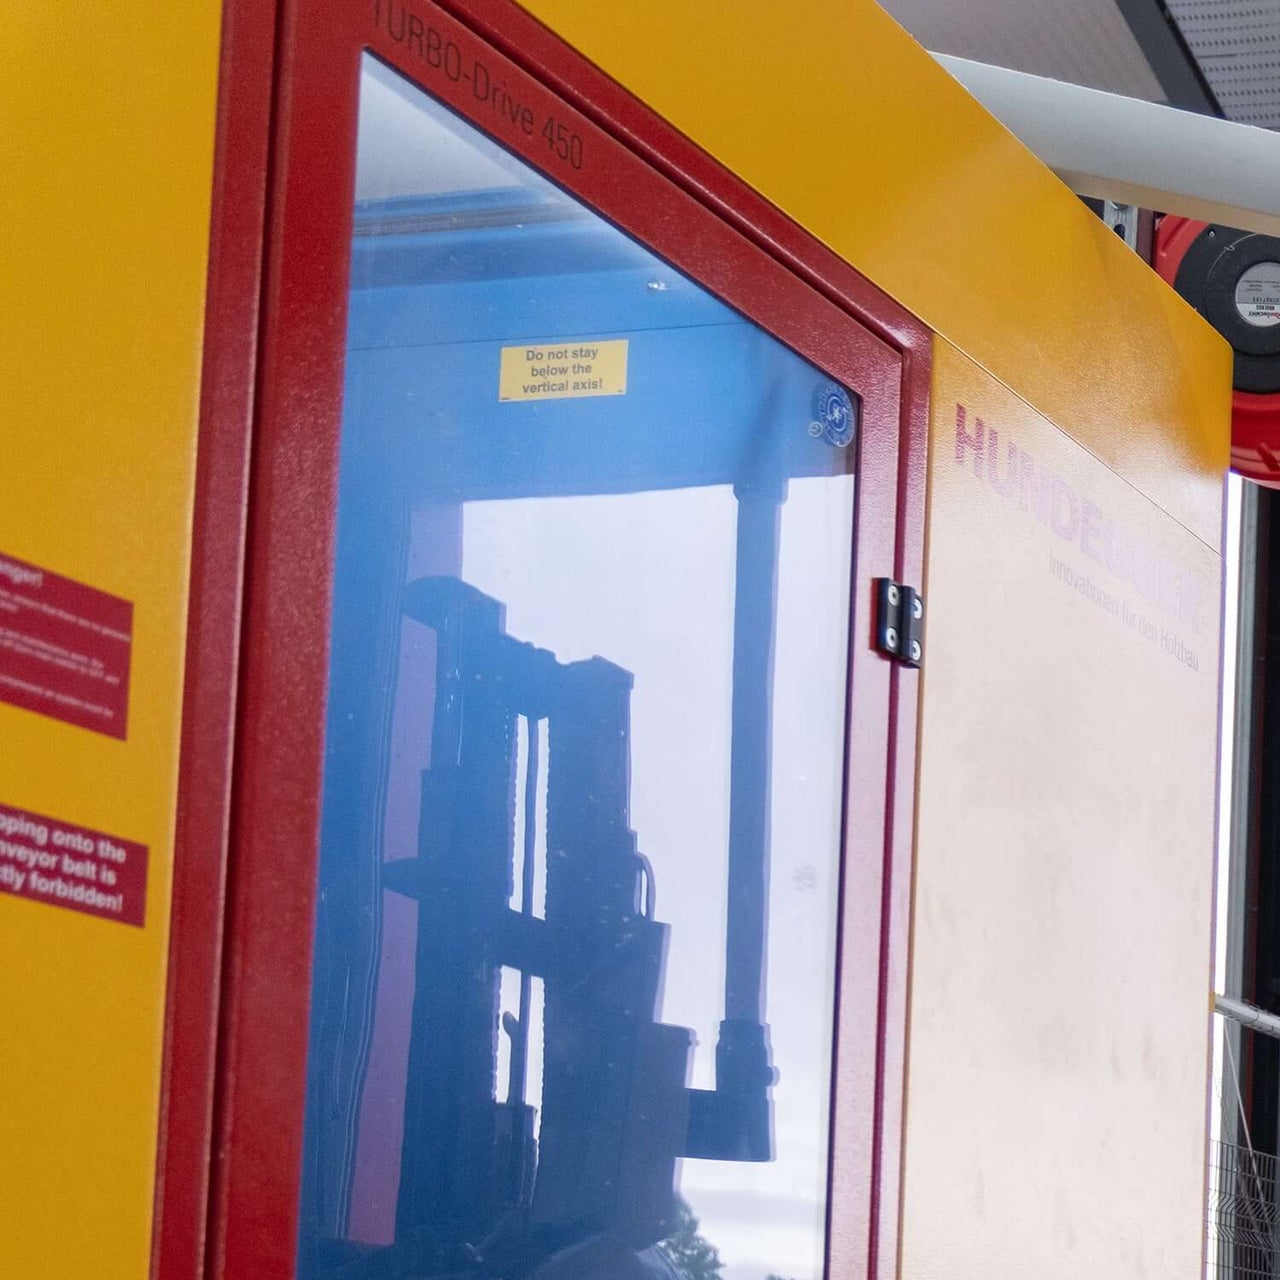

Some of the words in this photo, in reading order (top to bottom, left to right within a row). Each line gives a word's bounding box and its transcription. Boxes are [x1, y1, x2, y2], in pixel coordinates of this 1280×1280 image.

[542, 117, 582, 170] 450
[526, 350, 544, 361] Do
[547, 348, 568, 360] not
[571, 347, 598, 360] stay
[531, 365, 568, 377] below
[572, 363, 592, 374] the
[523, 380, 569, 394] vertical
[572, 378, 603, 390] axis!
[1049, 547, 1119, 619] Innovationen
[1138, 618, 1158, 643] den
[1160, 631, 1200, 672] Holzbau
[52, 830, 94, 854] onto
[97, 839, 126, 864] the
[62, 854, 97, 880] belt
[100, 864, 117, 886] is
[29, 871, 123, 912] forbidden!
